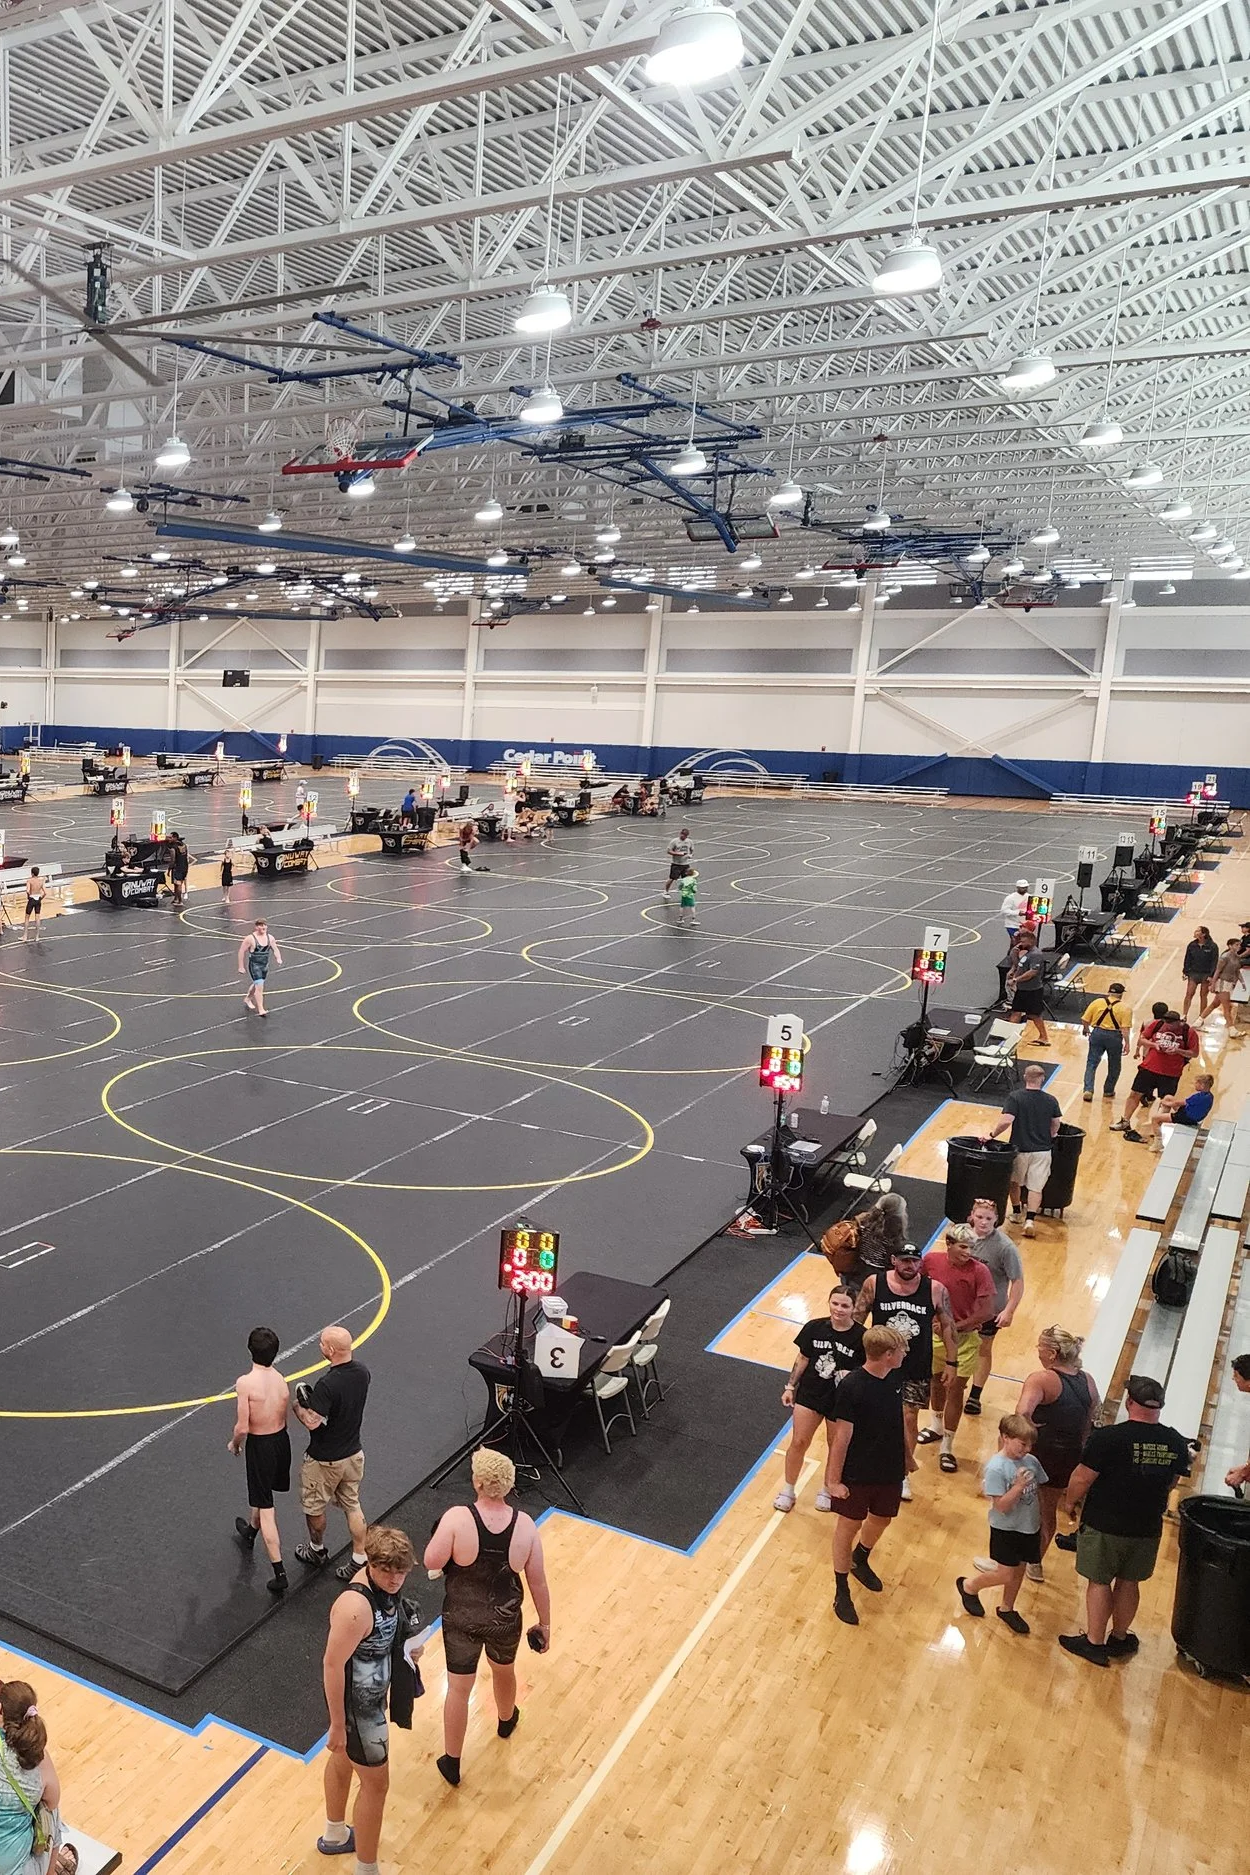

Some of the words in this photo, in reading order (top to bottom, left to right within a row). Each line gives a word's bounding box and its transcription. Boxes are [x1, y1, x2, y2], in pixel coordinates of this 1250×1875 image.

[1087, 851, 1096, 859] 11
[1041, 884, 1048, 893] 9
[933, 935, 941, 946] 7
[781, 1026, 792, 1041] 5
[516, 1230, 530, 1249] 0
[541, 1232, 553, 1250] 0
[513, 1248, 527, 1266] 0
[512, 1270, 553, 1291] 2:00
[879, 1301, 927, 1315] SILVERBACK
